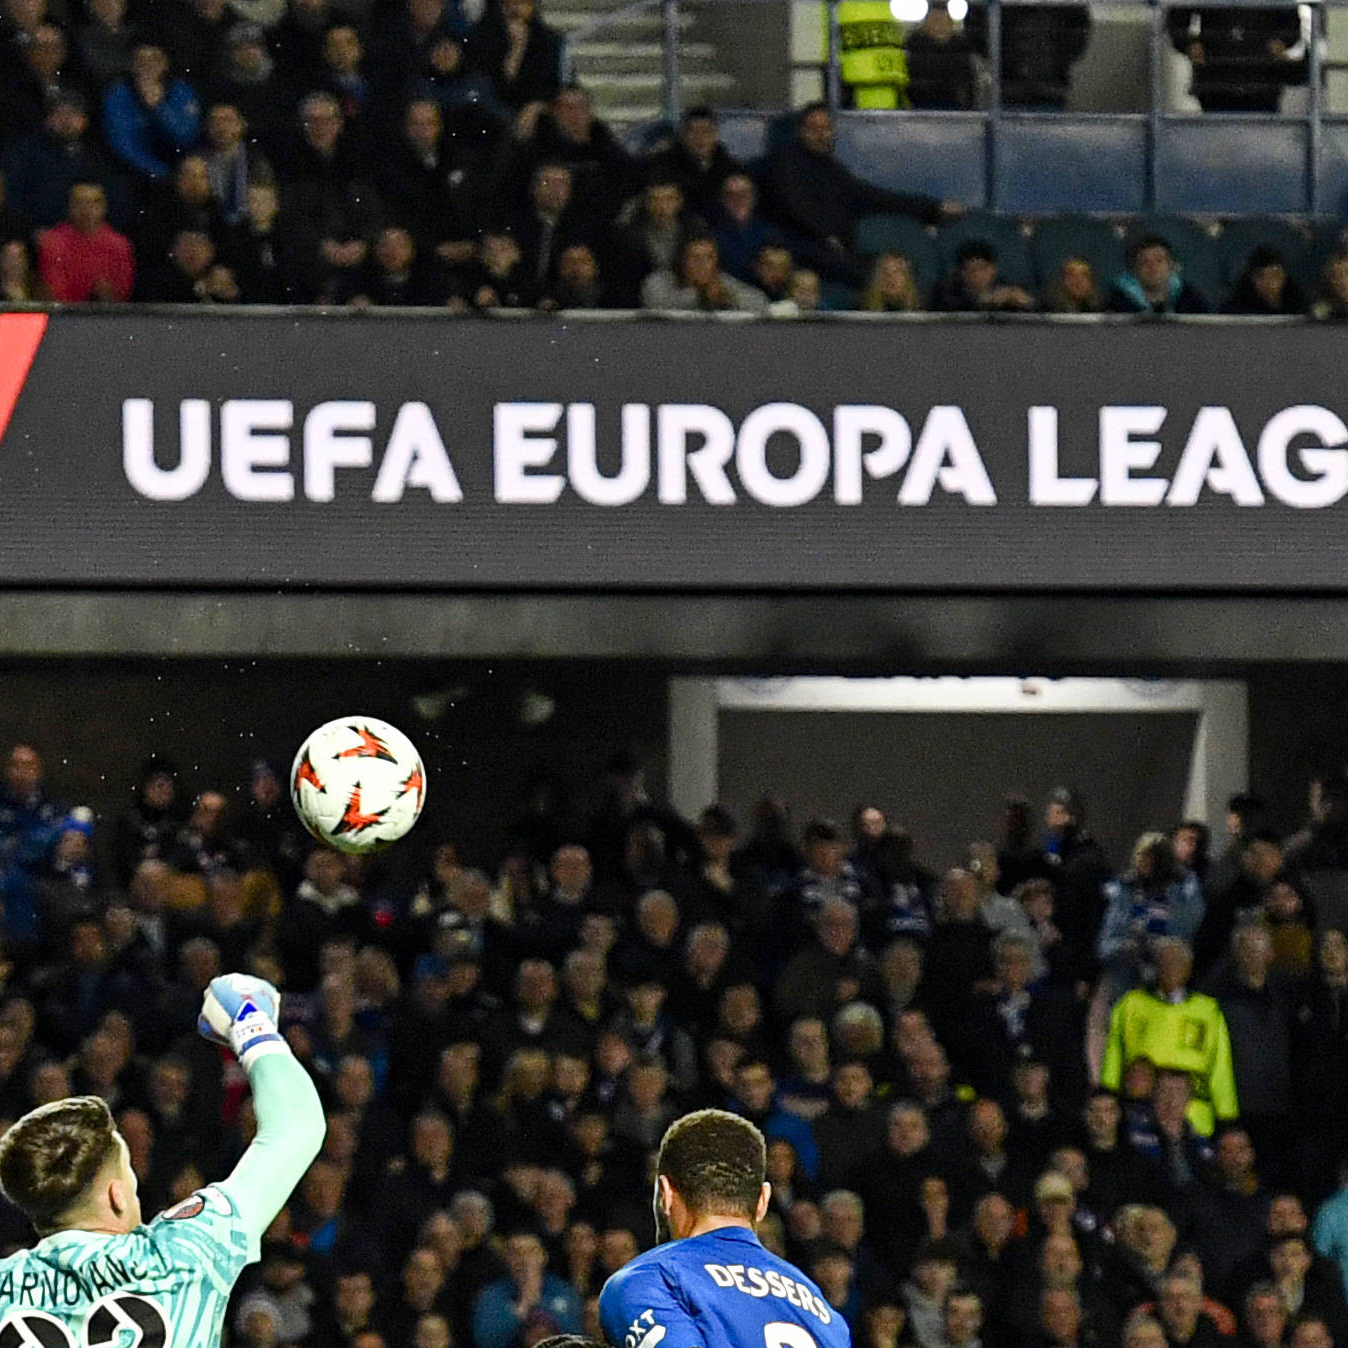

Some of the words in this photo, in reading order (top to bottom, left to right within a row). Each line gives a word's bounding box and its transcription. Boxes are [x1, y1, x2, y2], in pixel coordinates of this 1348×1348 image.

[123, 399, 464, 503] UEFA
[494, 403, 998, 508] EUROPA
[704, 1264, 832, 1325] DESSERS
